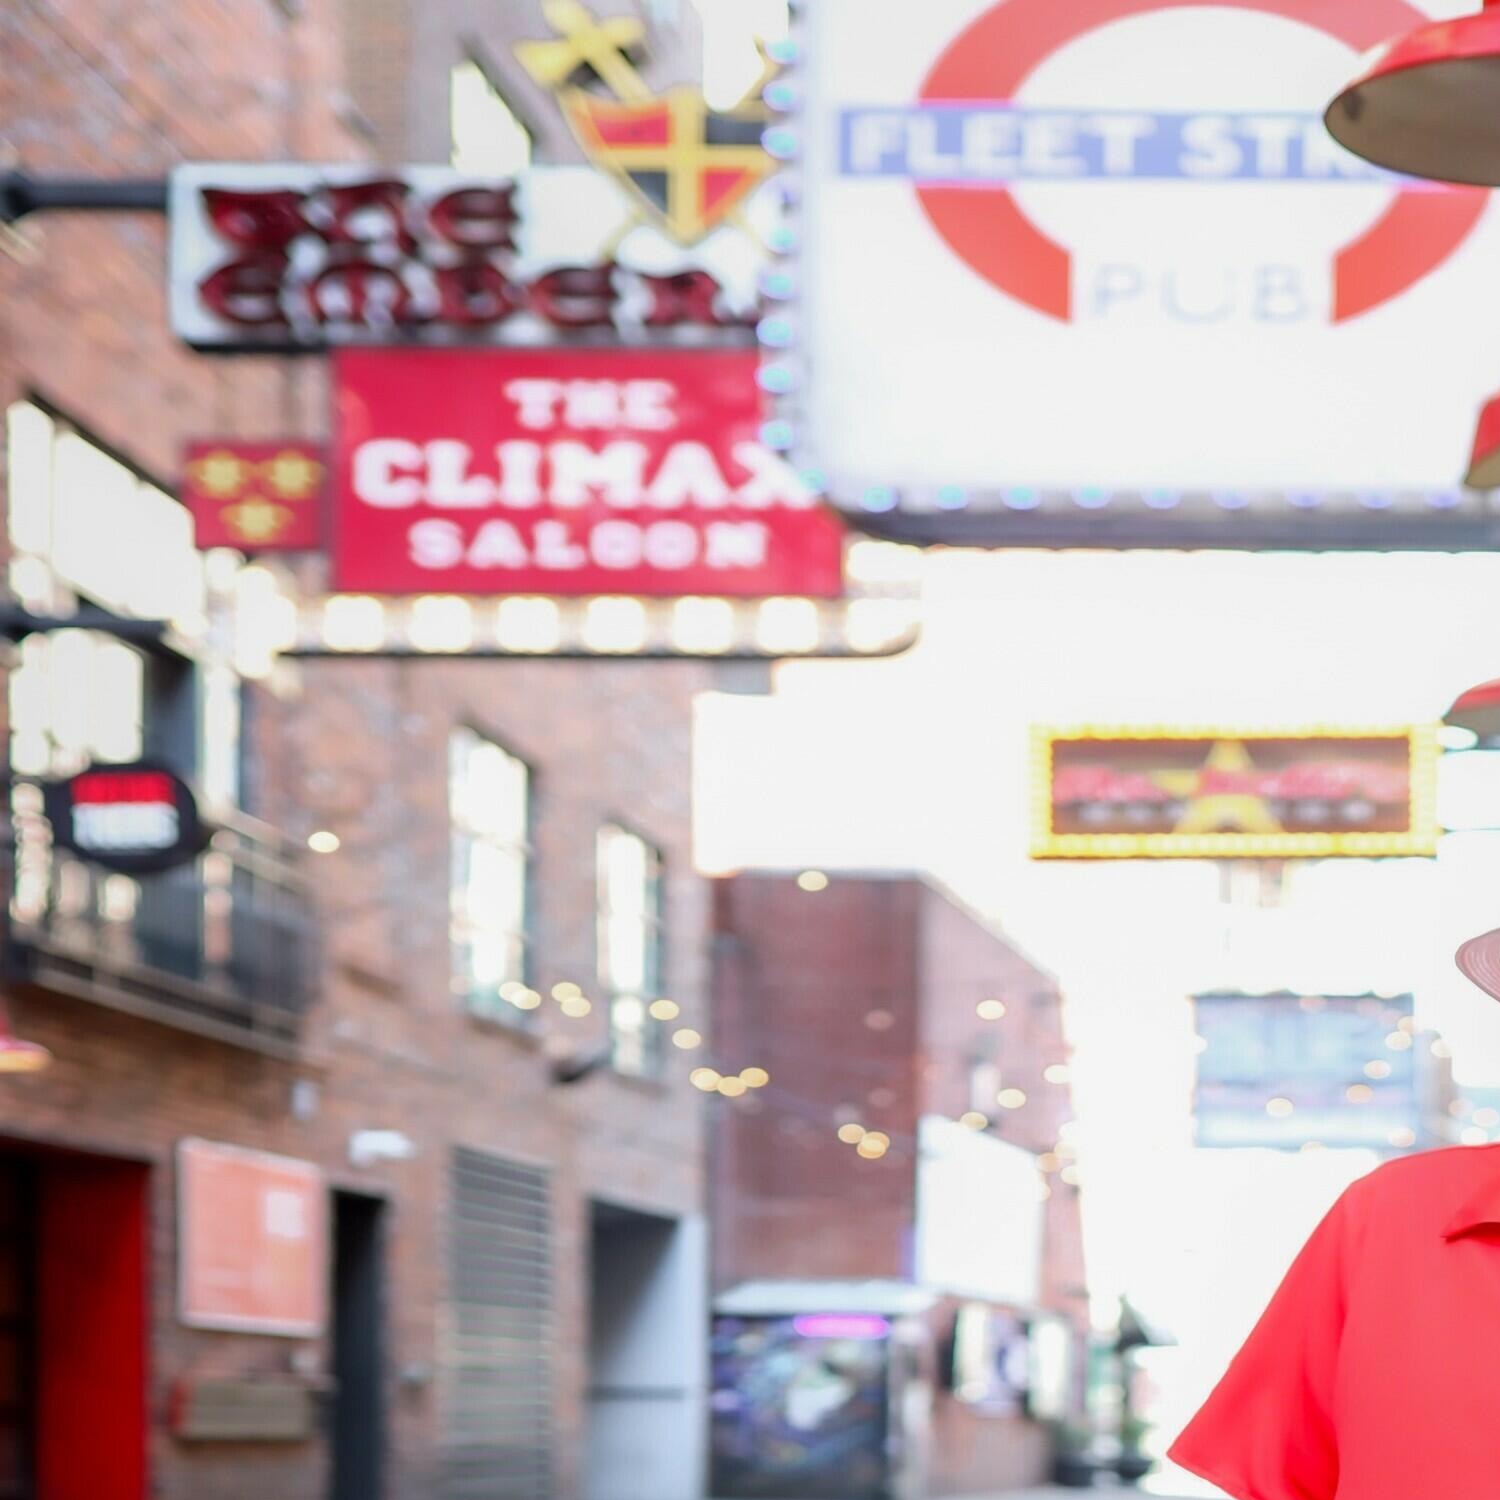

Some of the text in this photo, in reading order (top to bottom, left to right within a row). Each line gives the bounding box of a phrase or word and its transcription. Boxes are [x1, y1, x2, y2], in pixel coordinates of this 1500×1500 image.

[851, 111, 1158, 178] FLEET
[1090, 262, 1314, 325] PUB
[505, 379, 679, 431] THE
[353, 439, 824, 510] CLIMAX
[407, 519, 769, 571] SALOON
